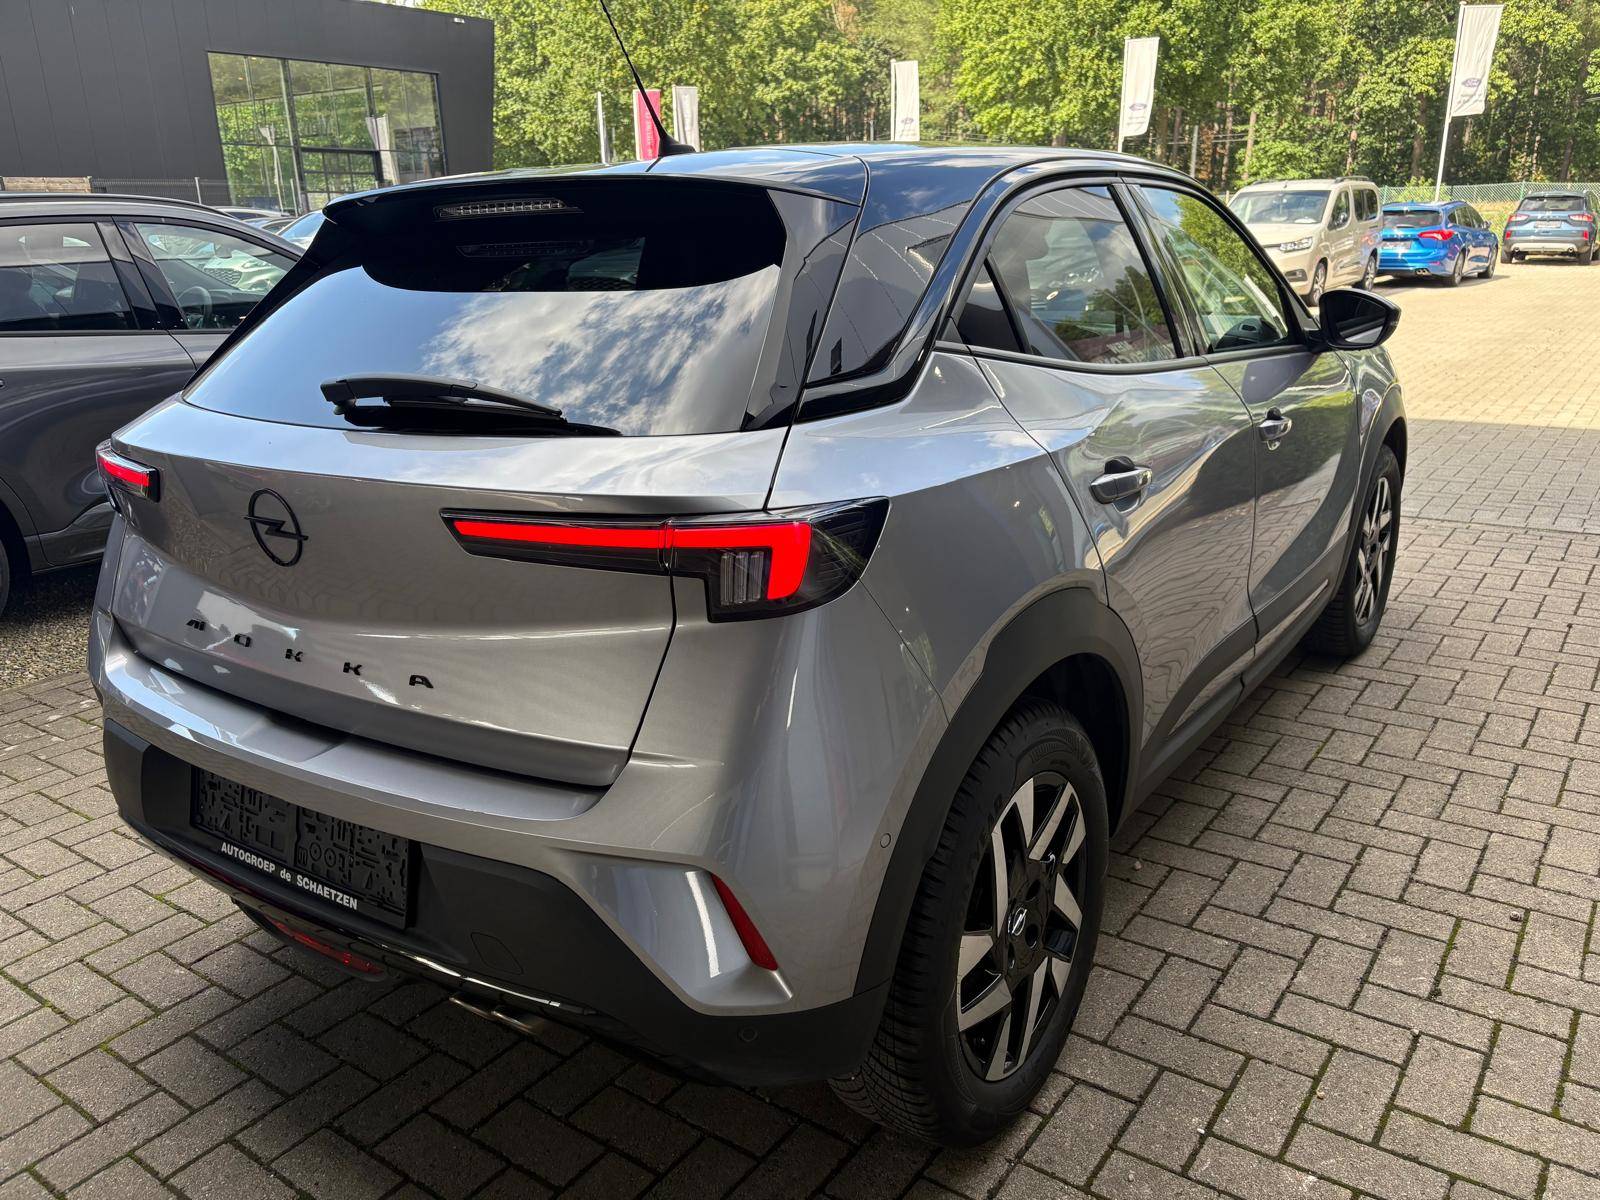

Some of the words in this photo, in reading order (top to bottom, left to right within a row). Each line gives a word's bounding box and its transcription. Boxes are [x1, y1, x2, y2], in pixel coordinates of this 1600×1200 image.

[187, 618, 434, 689] MOKKA
[221, 842, 276, 874] AUTOGROEP
[280, 868, 292, 882] de
[296, 874, 358, 910] SCHAETZEN
